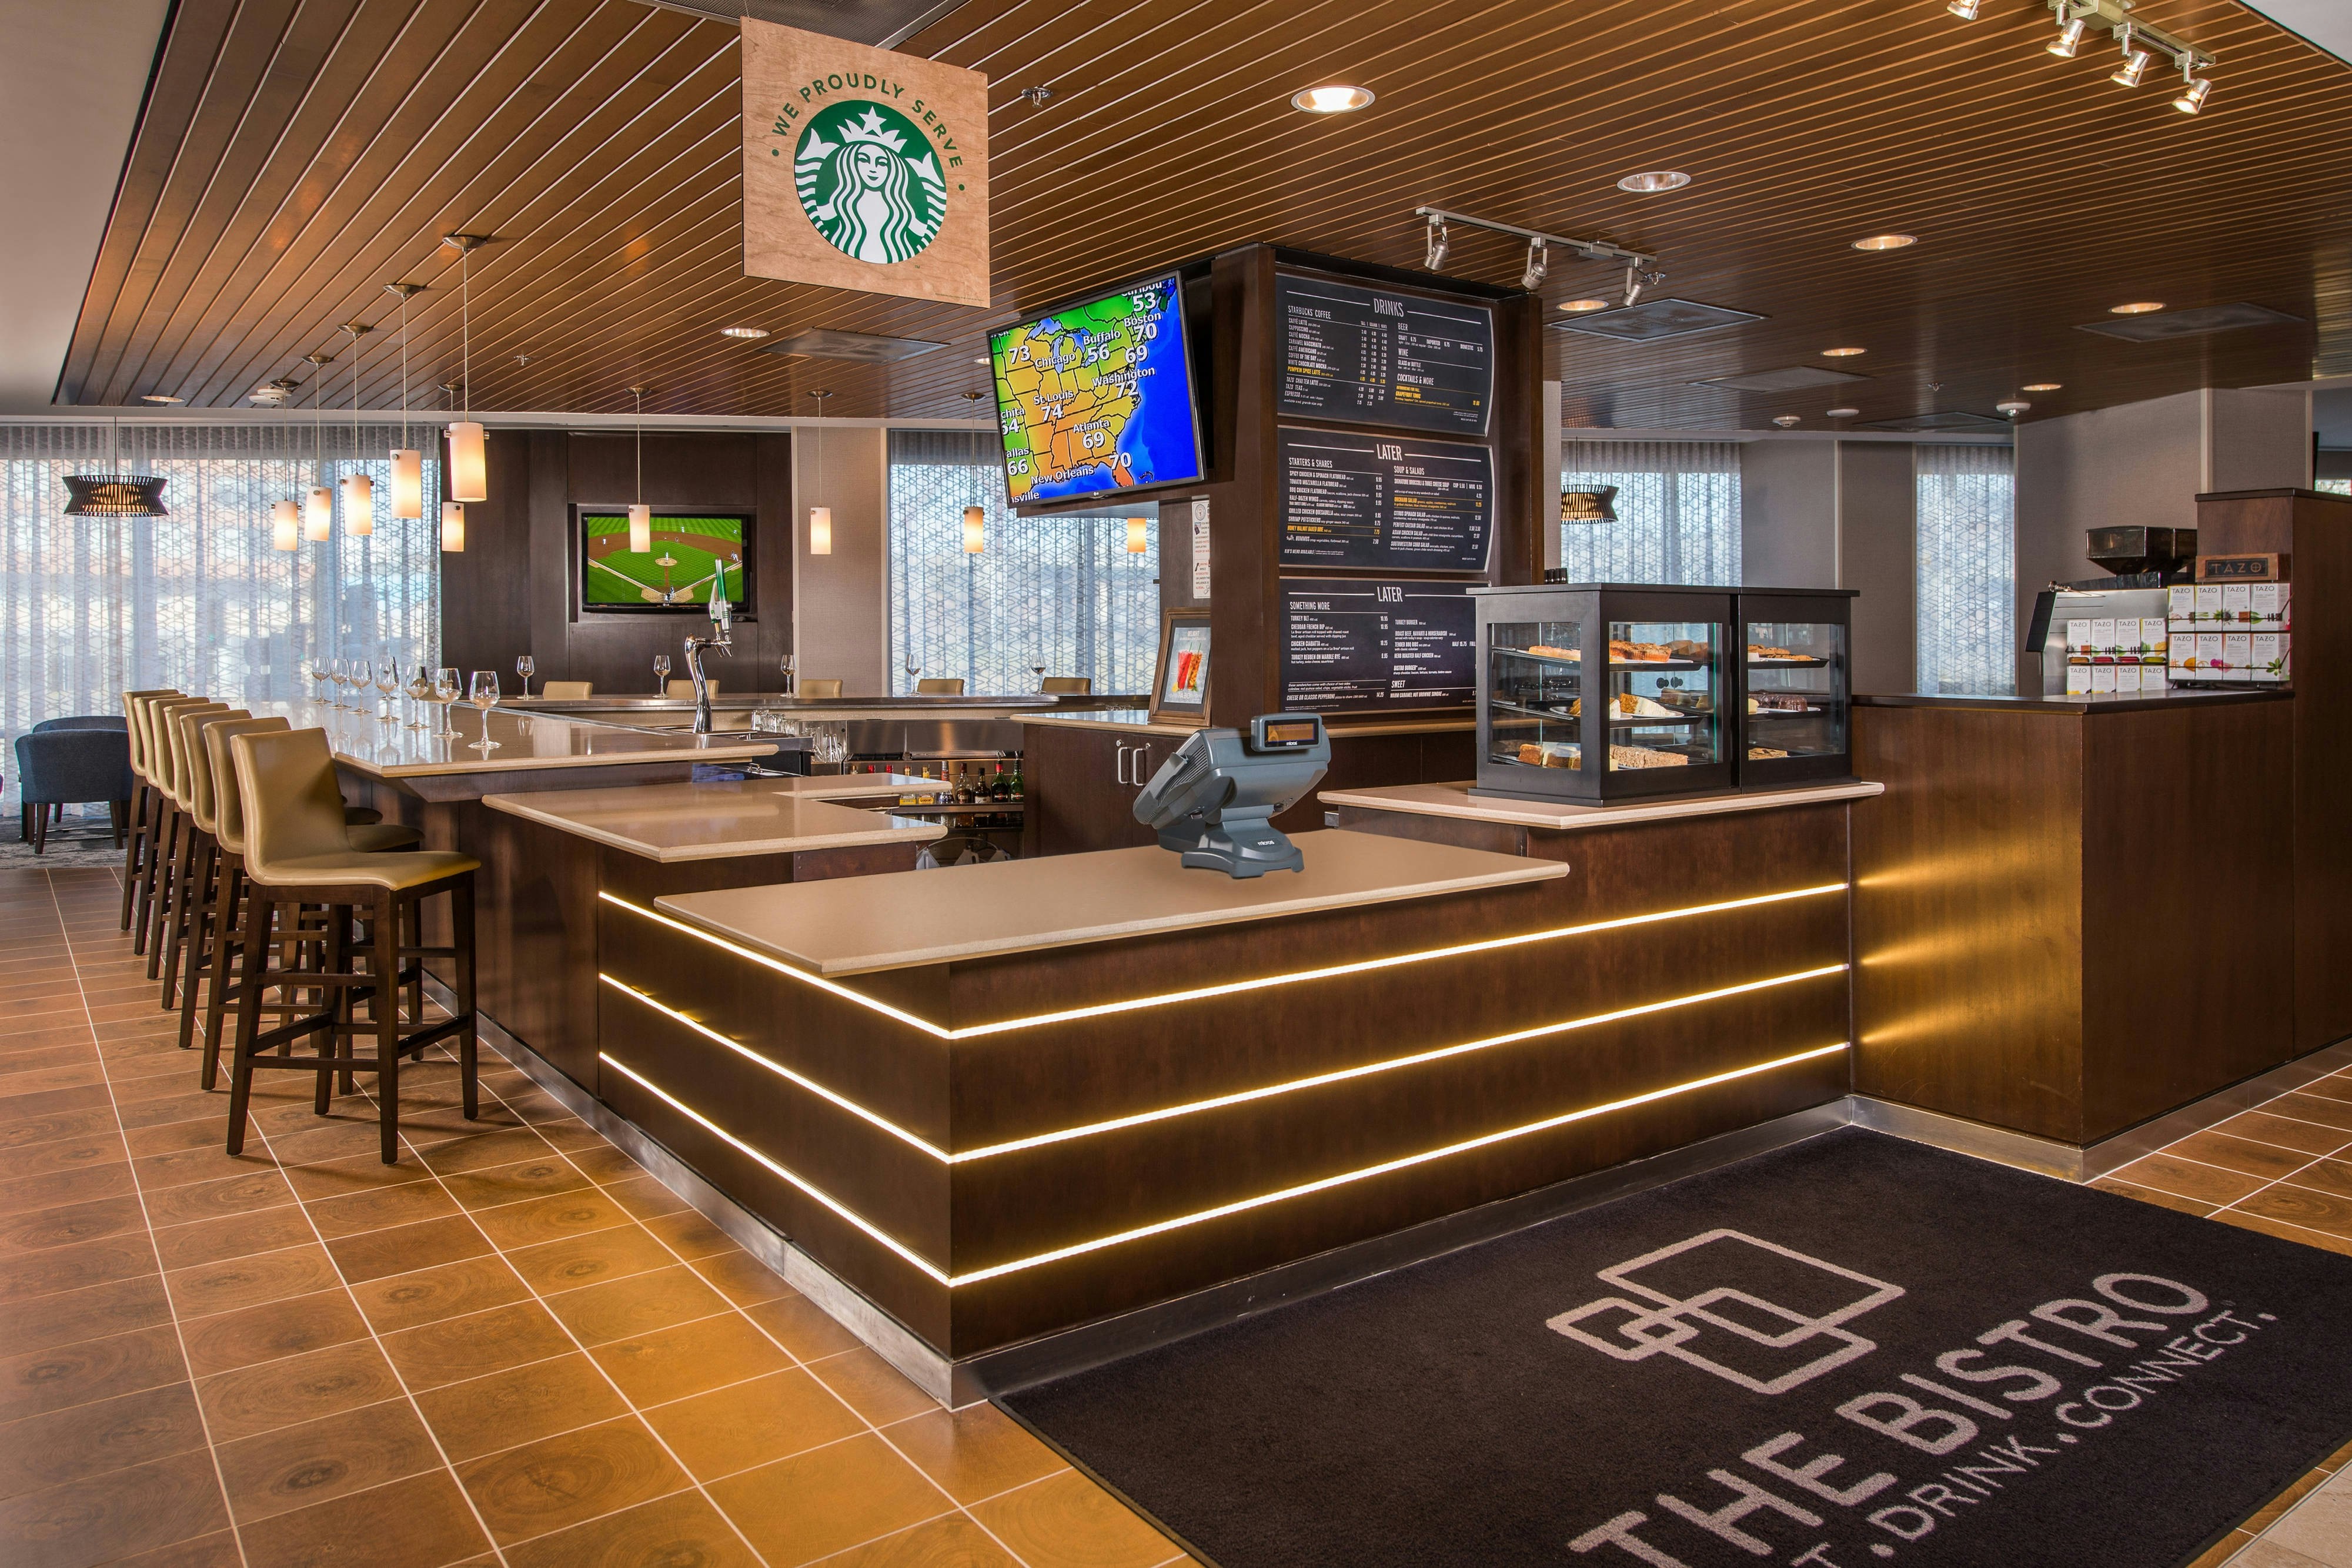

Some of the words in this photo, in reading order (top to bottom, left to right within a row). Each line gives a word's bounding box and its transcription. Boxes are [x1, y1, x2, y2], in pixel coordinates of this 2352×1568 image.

[772, 103, 800, 136] WE
[799, 73, 904, 103] PROUDLY
[912, 99, 963, 168] SERVE
[1133, 292, 1155, 312] 53
[1374, 298, 1404, 317] DRINKS
[1124, 313, 1161, 327] Boston
[1288, 306, 1312, 316] STARBUCKS
[1315, 310, 1331, 319] COFFEE
[1083, 330, 1120, 345] Buffalo
[1134, 323, 1157, 342] 70
[1008, 345, 1030, 363] 73
[1035, 353, 1075, 367] Chicago
[1088, 344, 1110, 362] 56
[1125, 345, 1147, 363] 69
[1398, 348, 1408, 356] WINE
[1092, 367, 1155, 386] Washington
[1397, 373, 1418, 383] COCKTAILS
[1423, 377, 1434, 385] MORE
[1115, 380, 1138, 397] 72
[1034, 395, 1045, 404] St
[1047, 391, 1074, 402] Louis
[1041, 404, 1063, 422] 74
[1073, 420, 1110, 433] Atlanta
[1083, 432, 1104, 449] 69
[1109, 452, 1131, 469] 70
[1377, 444, 1402, 461] LATER
[1008, 459, 1028, 476] 66
[1289, 457, 1311, 466] STARTERS
[1316, 460, 1332, 468] SHARES
[1394, 466, 1405, 474] SOUP
[1031, 475, 1053, 484] New
[1055, 467, 1094, 480] Orleans
[2211, 562, 2261, 574] TAZO
[1377, 586, 1403, 602] LATER
[1290, 601, 1316, 610] SOMETHING
[1318, 602, 1330, 610] MORE
[1567, 1430, 1898, 1568] THE
[1835, 1272, 2210, 1456] BISTRO
